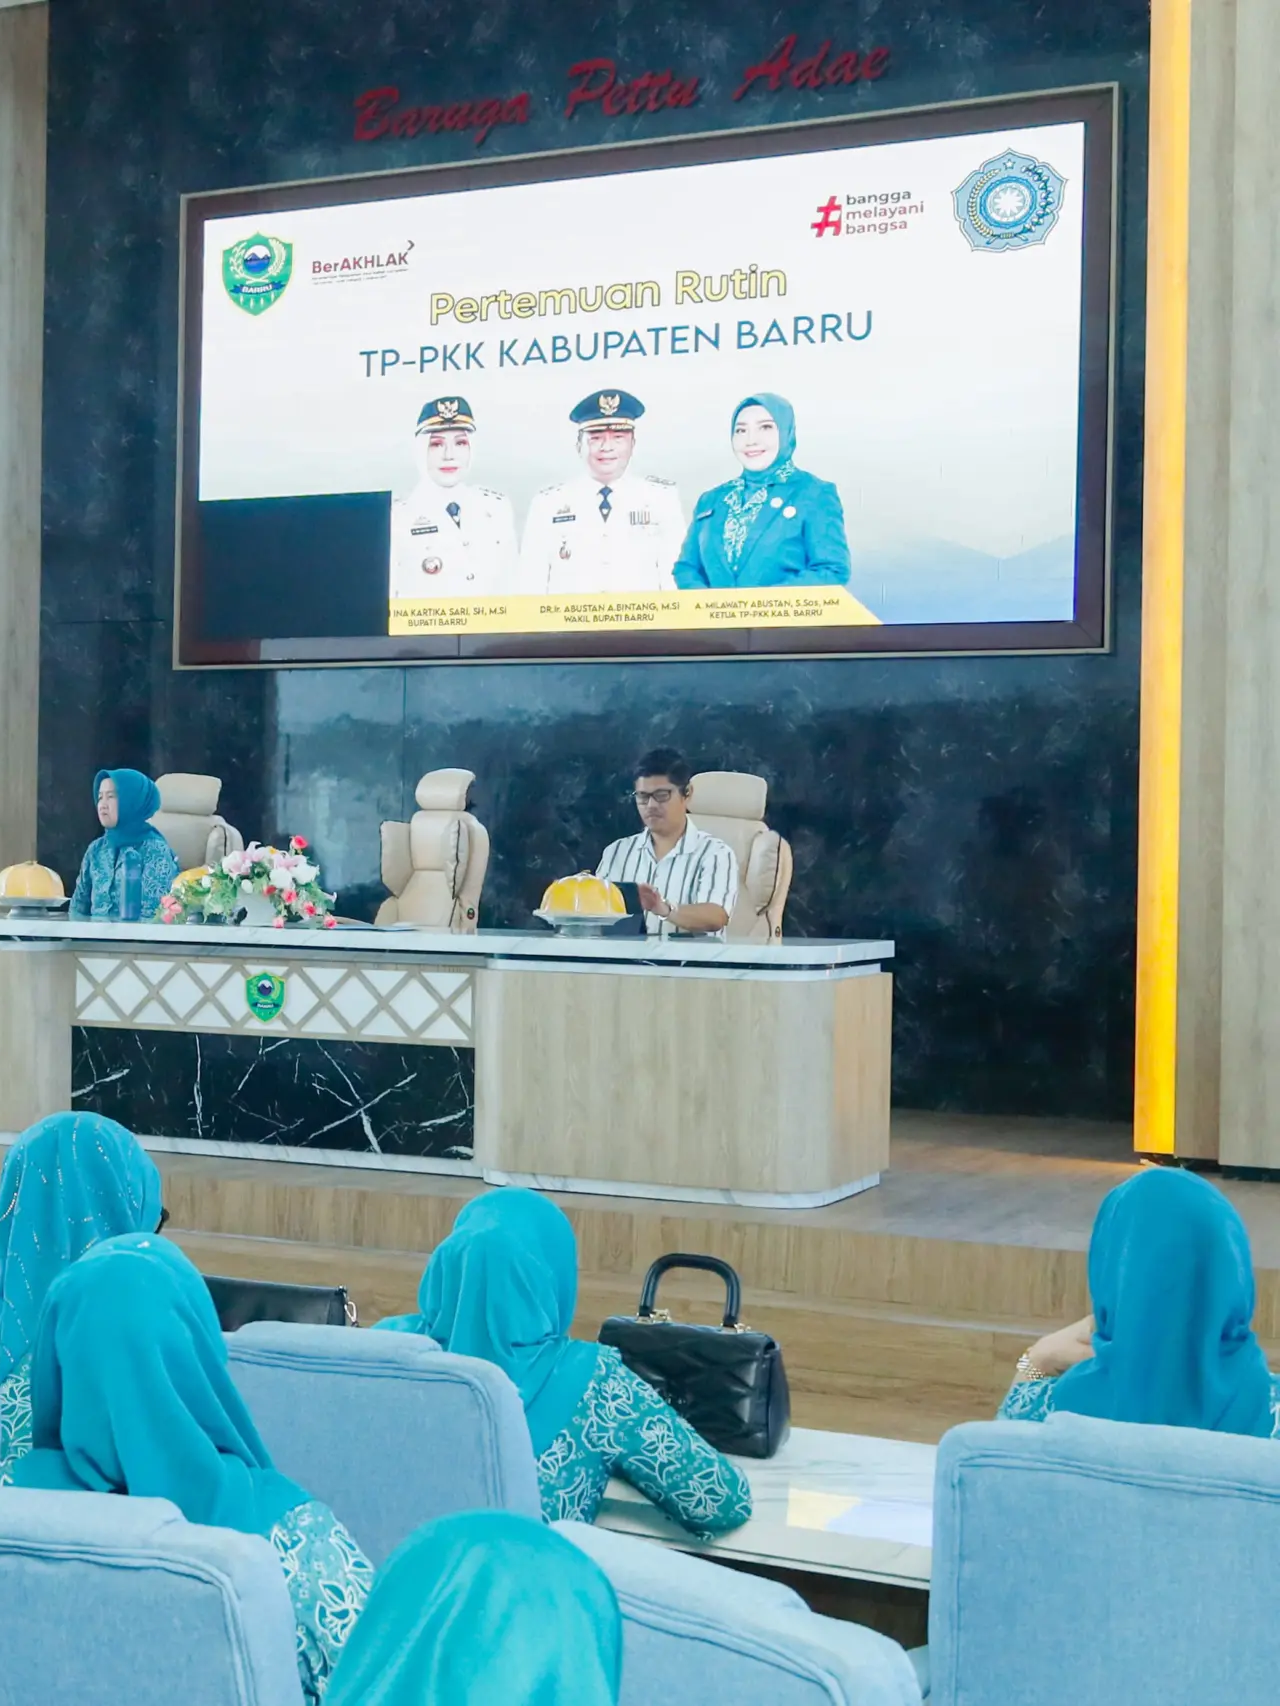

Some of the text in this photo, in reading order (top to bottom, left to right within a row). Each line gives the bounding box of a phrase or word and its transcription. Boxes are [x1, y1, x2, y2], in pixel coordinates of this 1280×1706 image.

[354, 34, 890, 146] Baruga Pettu Adae
[846, 190, 912, 206] bangga
[846, 200, 924, 220] melayani
[846, 220, 908, 235] bangsa
[311, 252, 409, 275] BerAKHLAK
[429, 263, 788, 326] Pertemuan Rutin
[358, 309, 874, 378] TP-PKK KABUPATEN BARRU
[564, 603, 605, 613] ABUSTAN
[705, 600, 748, 609] MILAWATY
[823, 598, 840, 607] MM
[393, 608, 409, 618] INA
[410, 607, 446, 617] KARTIKA
[564, 613, 655, 623] WAKIL BUPATI BARRU
[709, 611, 737, 619] KETUA
[739, 610, 769, 618] TP-PKK
[793, 609, 823, 617] BARRU
[408, 617, 468, 627] BUPATI BARRU
